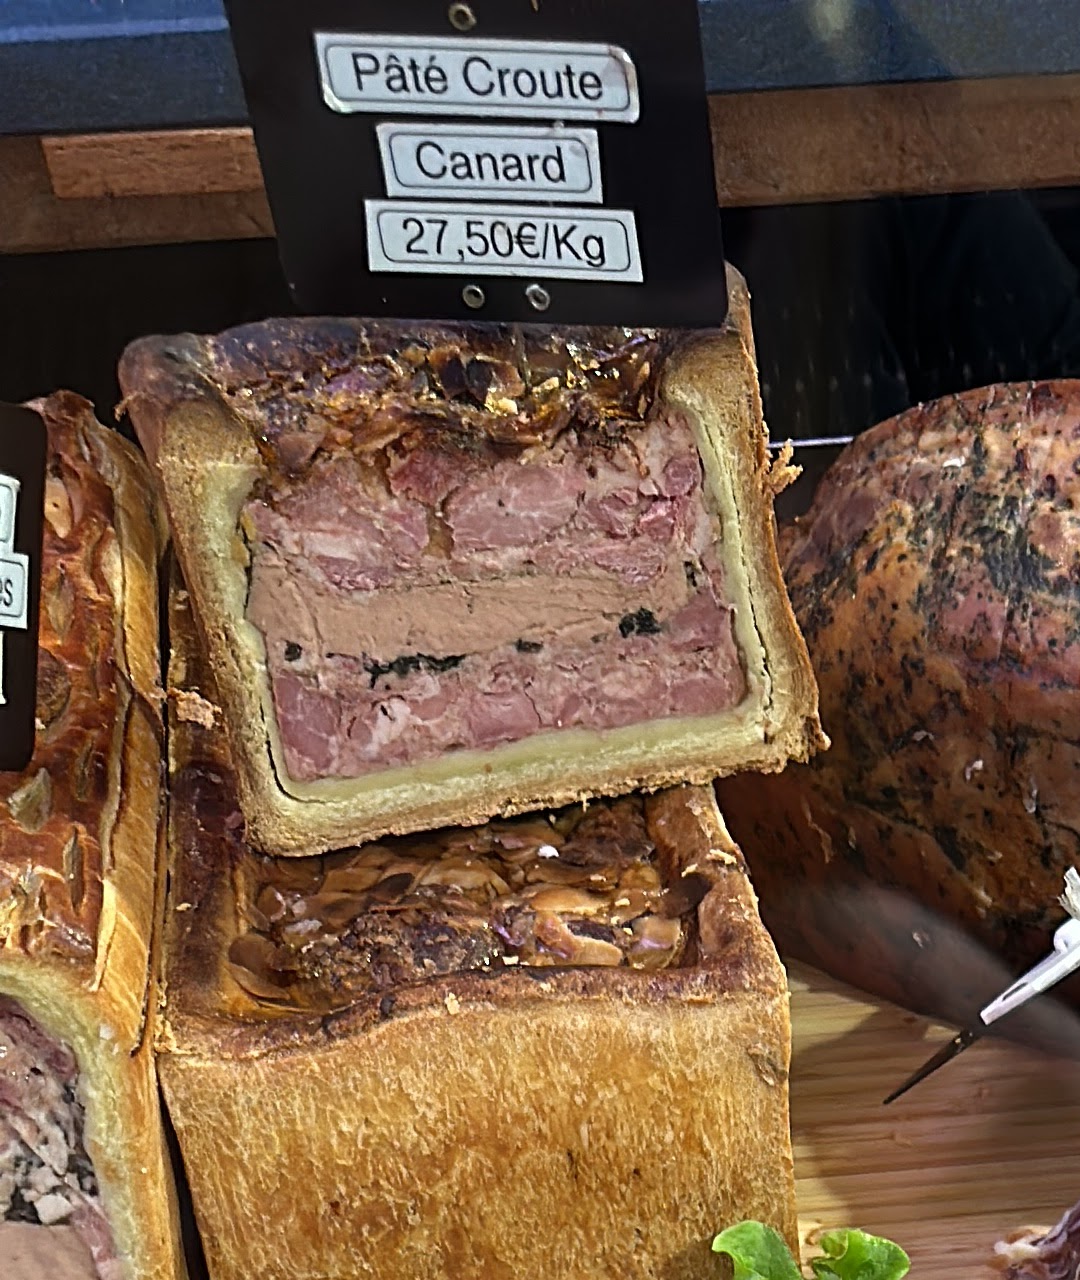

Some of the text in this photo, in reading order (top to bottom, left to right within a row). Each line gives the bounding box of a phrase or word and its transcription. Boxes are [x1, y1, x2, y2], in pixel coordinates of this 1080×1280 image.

[351, 52, 604, 101] Pâté Croute
[415, 140, 567, 184] Canard
[402, 217, 606, 266] 27,50€/Kg
